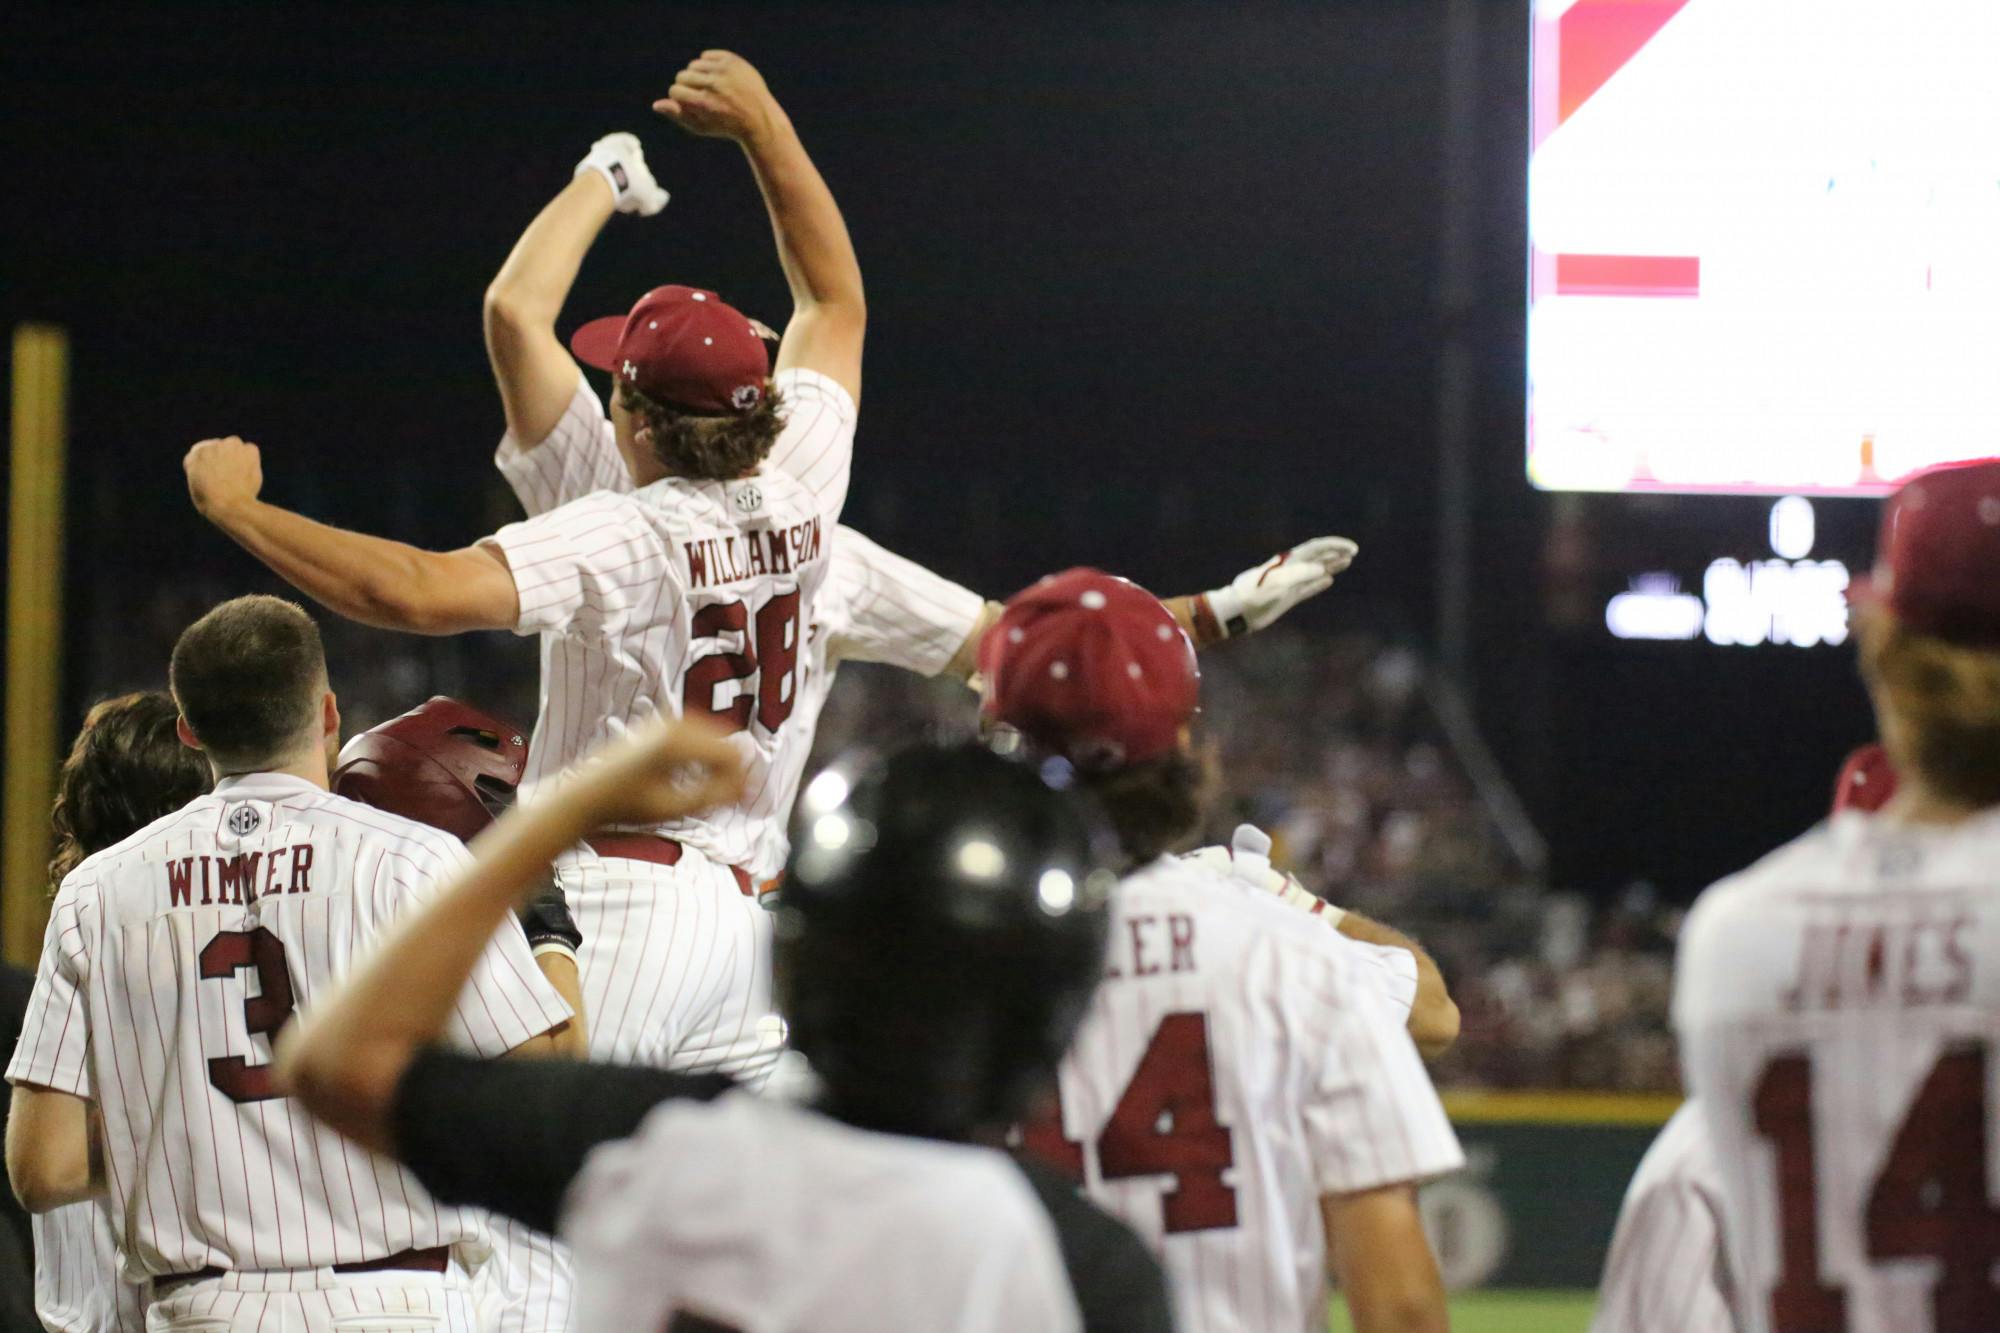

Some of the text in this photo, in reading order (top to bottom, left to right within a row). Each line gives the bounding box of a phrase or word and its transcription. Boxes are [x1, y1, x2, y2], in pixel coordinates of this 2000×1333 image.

[683, 583, 800, 734] 28
[166, 844, 313, 907] WIMMER
[229, 806, 261, 837] SEC
[1104, 912, 1196, 980] ER
[199, 926, 294, 1103] 3
[1751, 1036, 2000, 1333] 14
